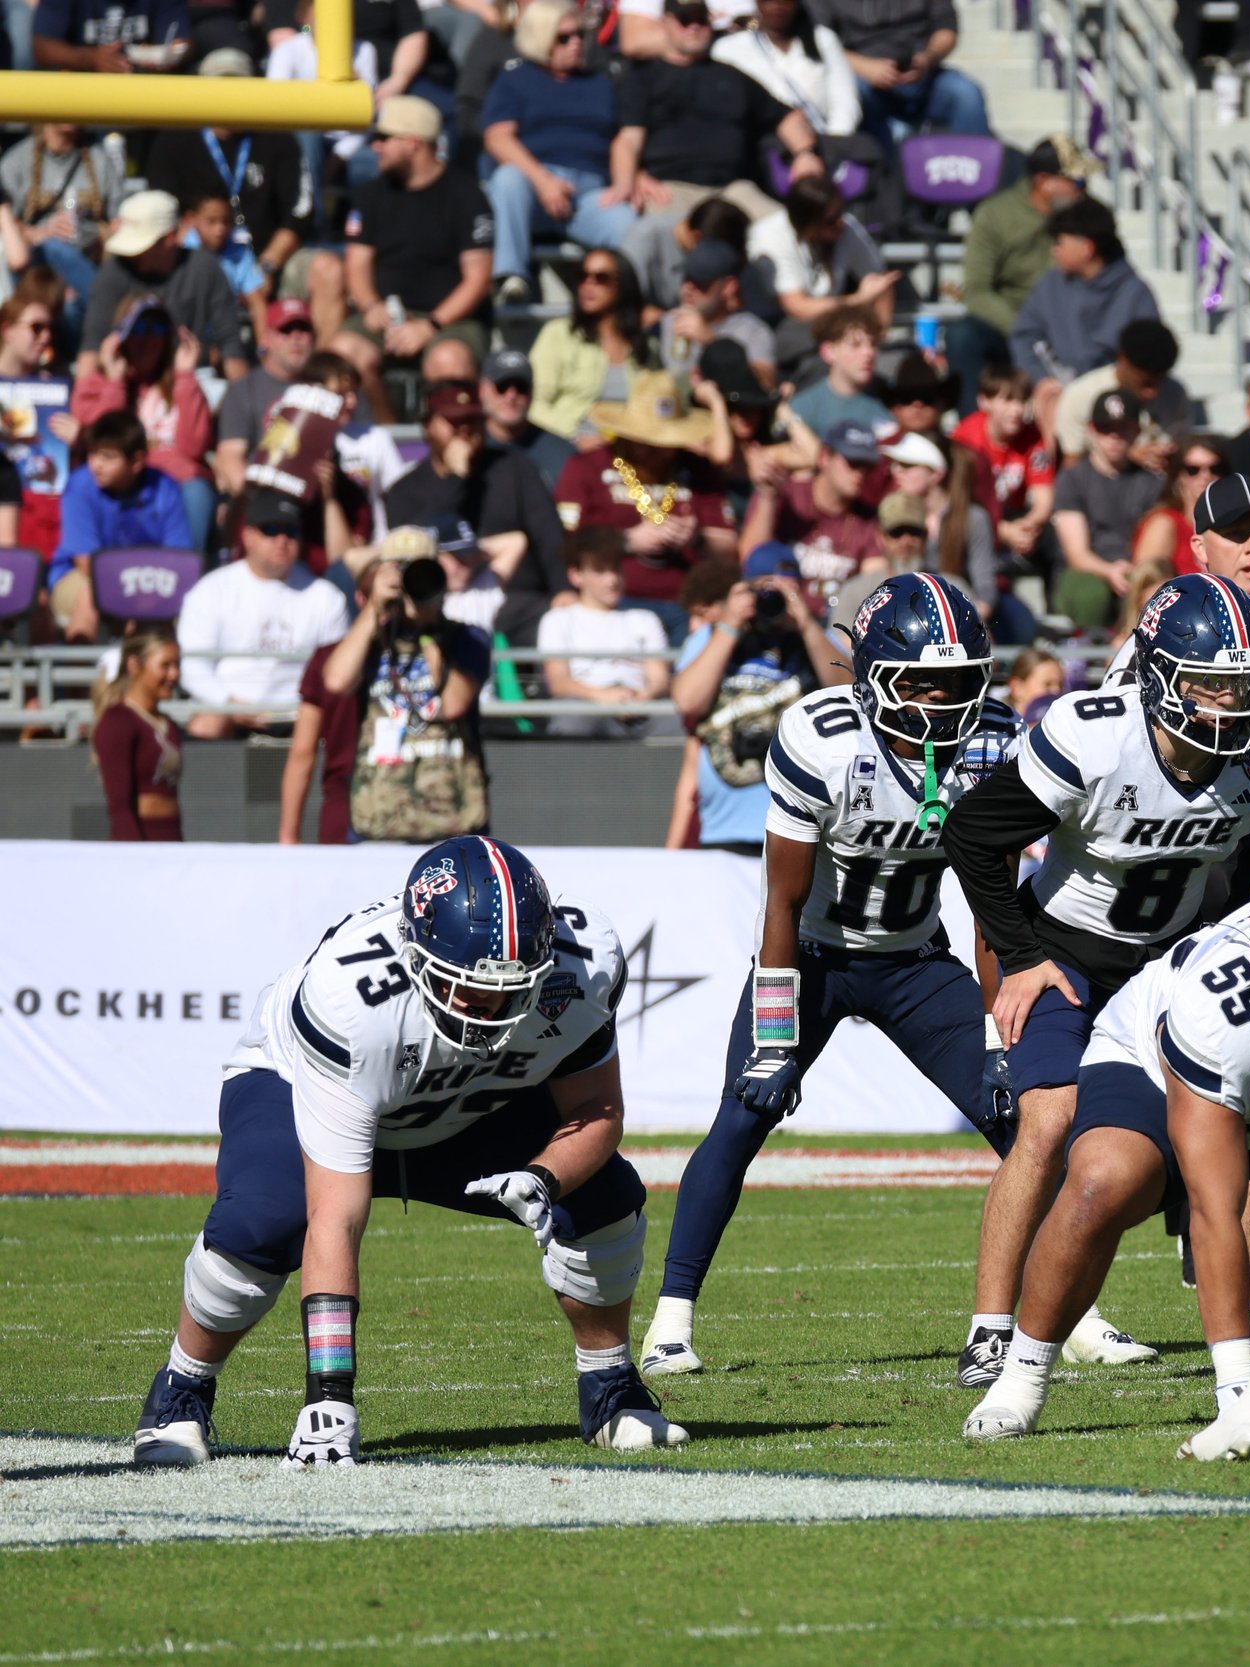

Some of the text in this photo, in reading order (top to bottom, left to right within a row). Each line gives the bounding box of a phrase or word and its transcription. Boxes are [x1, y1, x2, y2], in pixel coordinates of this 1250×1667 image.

[925, 156, 980, 185] TCU
[120, 566, 178, 598] TCU
[937, 647, 954, 657] WE
[1228, 650, 1247, 663] WE
[803, 696, 862, 738] 10
[1074, 696, 1126, 720] 8
[854, 820, 943, 849] RIC
[1121, 816, 1242, 847] RICE
[824, 856, 951, 933] 10
[1106, 858, 1204, 933] 8
[336, 932, 411, 1007] 73
[14, 988, 241, 1020] OCKHEE
